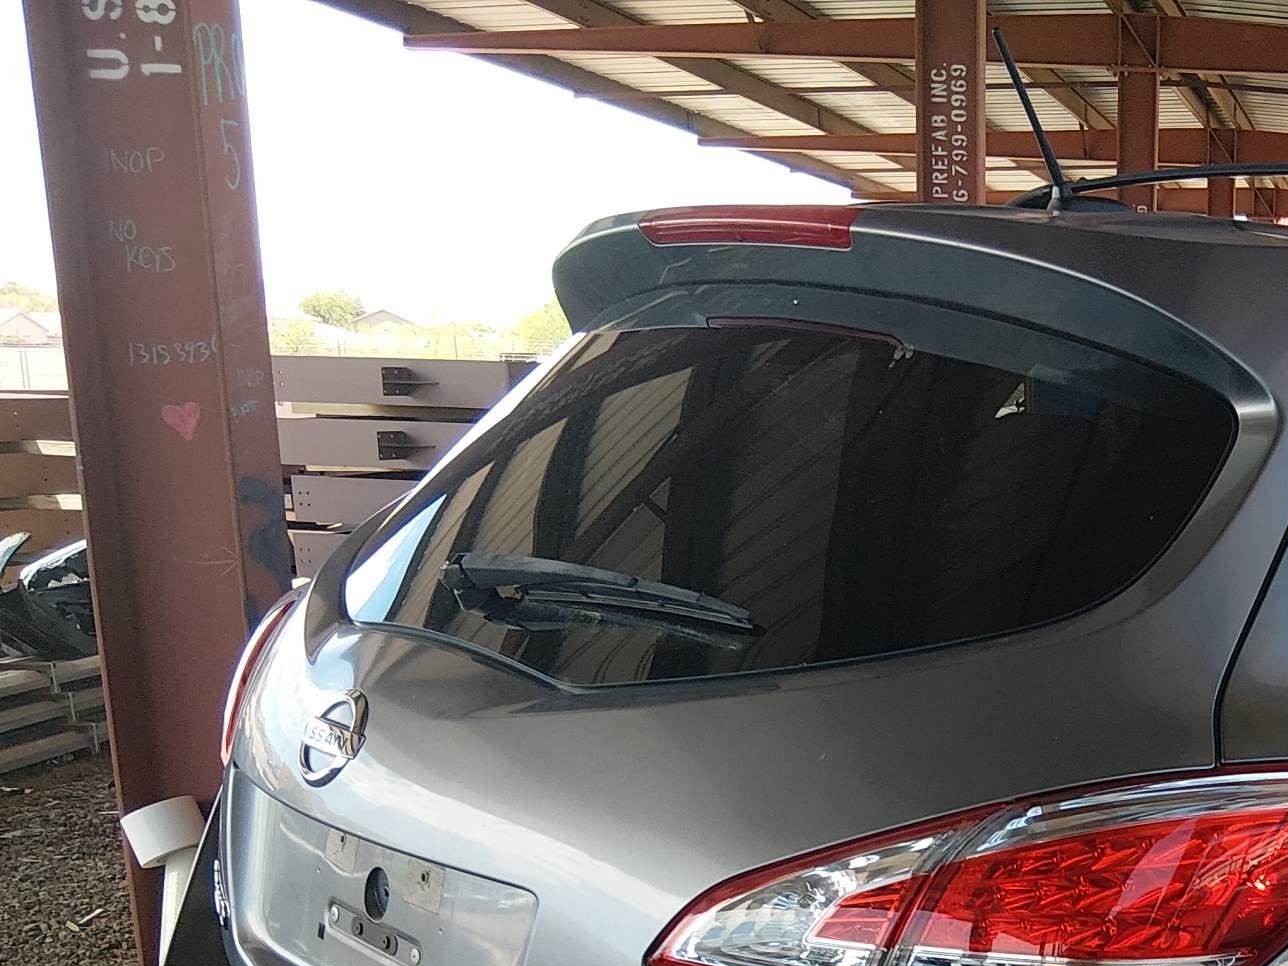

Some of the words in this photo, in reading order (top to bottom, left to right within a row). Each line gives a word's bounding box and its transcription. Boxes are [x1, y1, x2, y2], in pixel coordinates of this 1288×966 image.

[930, 62, 948, 103] INC.
[931, 114, 949, 198] PREFAB
[303, 720, 350, 753] ISSAN
